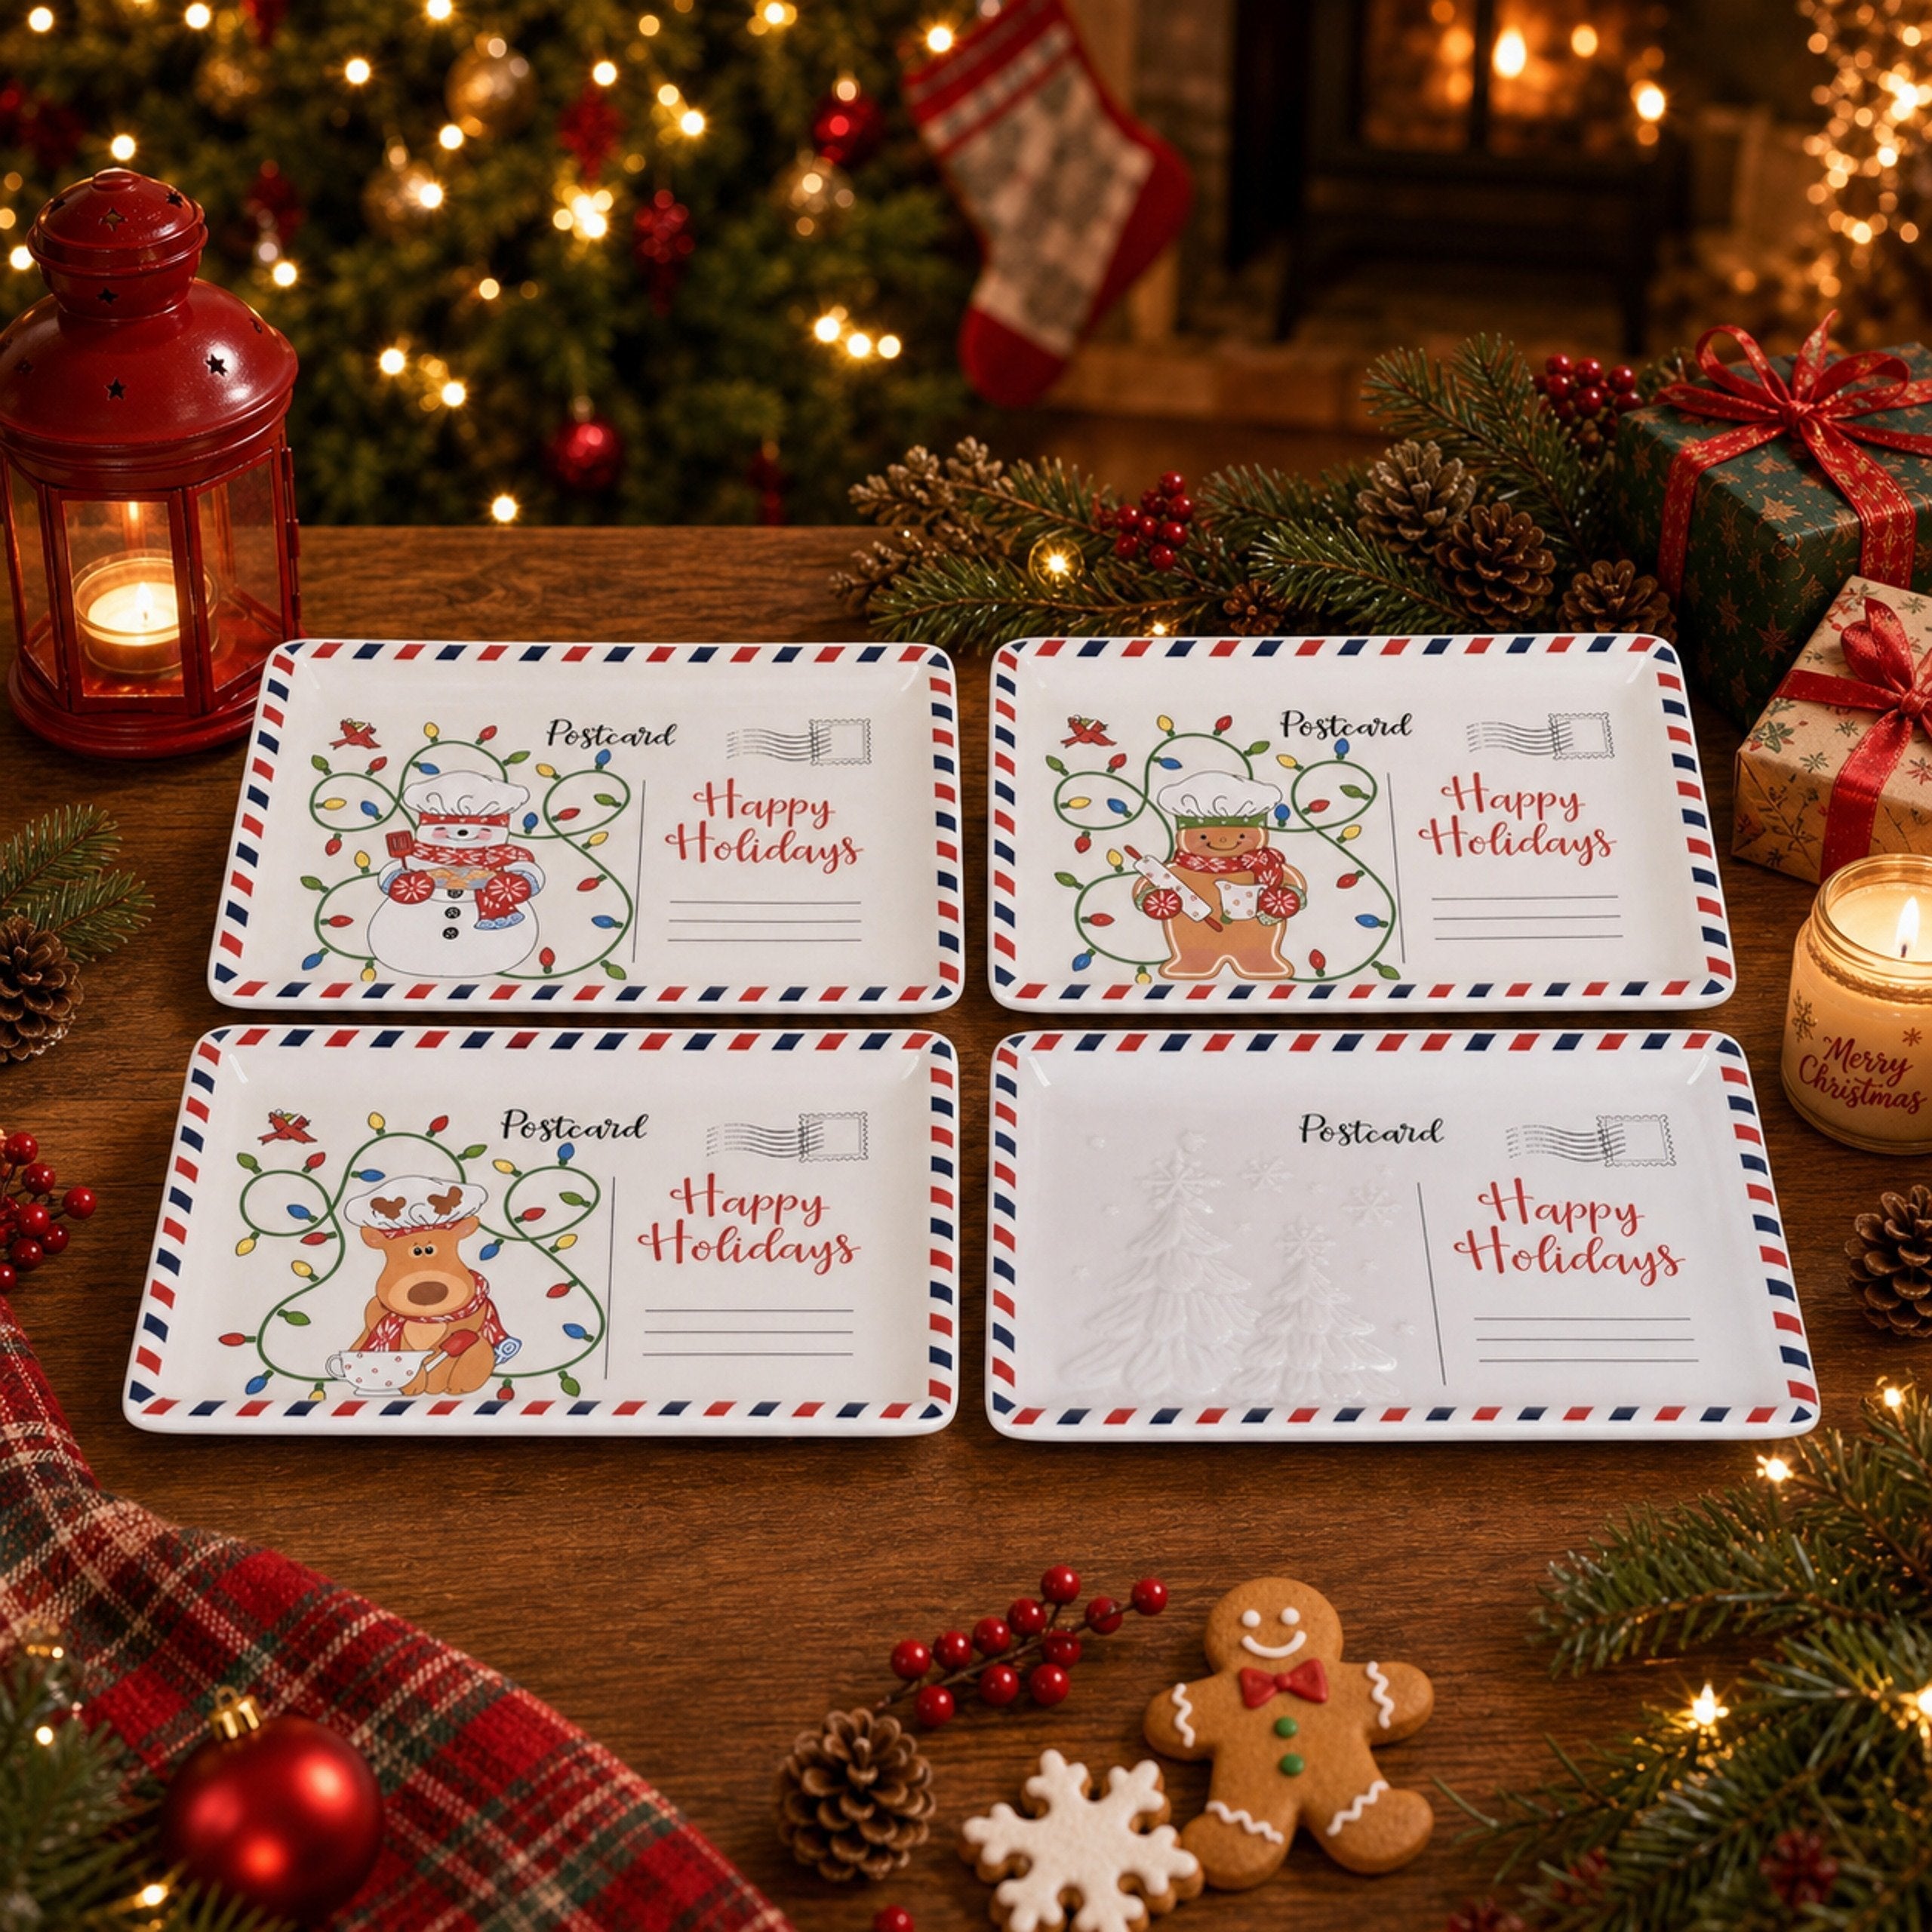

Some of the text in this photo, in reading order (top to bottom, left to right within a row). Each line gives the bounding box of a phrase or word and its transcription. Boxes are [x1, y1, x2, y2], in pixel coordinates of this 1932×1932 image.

[546, 718, 678, 750] Postcard
[1280, 709, 1413, 739] Postcard
[693, 777, 836, 830] Happy
[1441, 771, 1586, 822] Happy
[665, 820, 863, 874] Holidays
[1418, 814, 1617, 866] Holidays
[1799, 1054, 1928, 1115] Christmas
[1823, 1036, 1914, 1088] Merry
[501, 1109, 649, 1142] Postcard
[1299, 1112, 1444, 1146] Postcard
[669, 1172, 830, 1226] Happy
[1478, 1177, 1645, 1236] Happy
[638, 1219, 861, 1275] Holidays
[1454, 1225, 1686, 1287] Holidays
